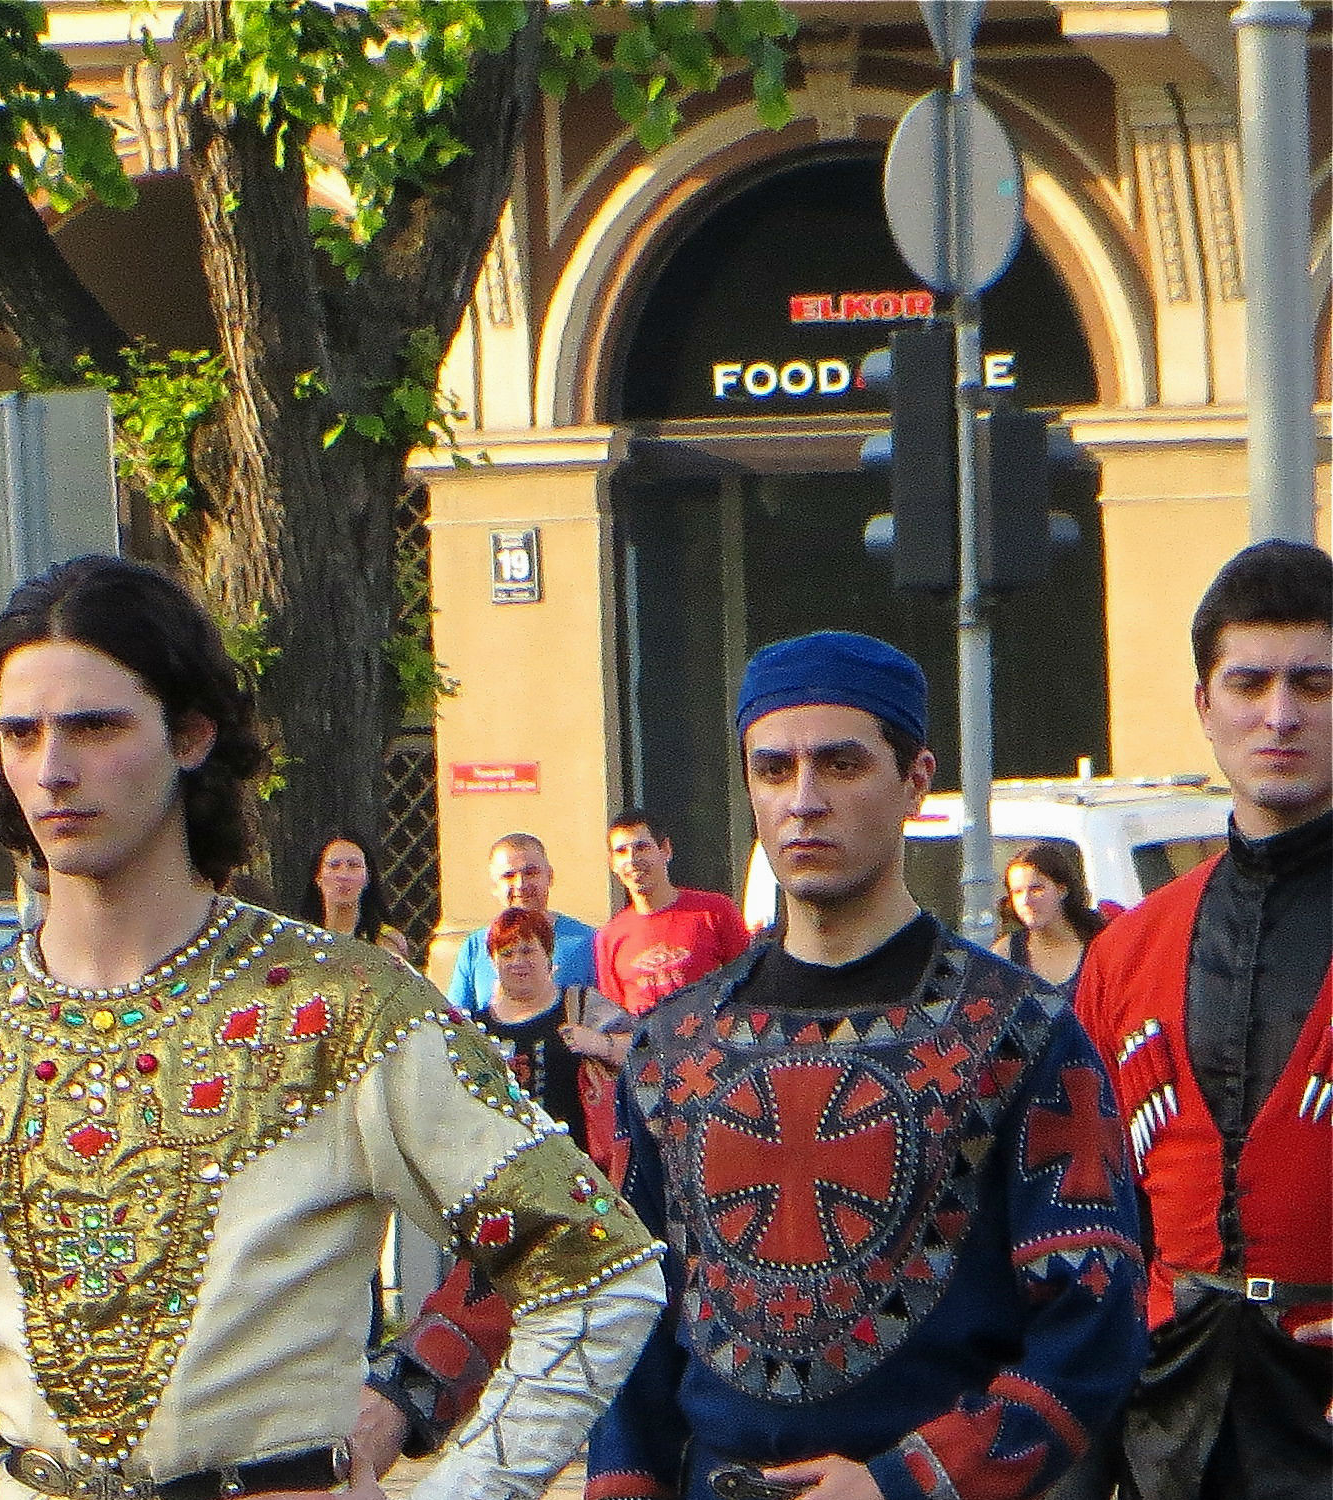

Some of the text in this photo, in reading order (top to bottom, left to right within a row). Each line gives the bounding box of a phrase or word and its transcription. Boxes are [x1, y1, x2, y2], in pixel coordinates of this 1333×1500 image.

[789, 290, 935, 323] ELKOR
[713, 358, 852, 401] FOOD
[496, 548, 531, 581] 19
